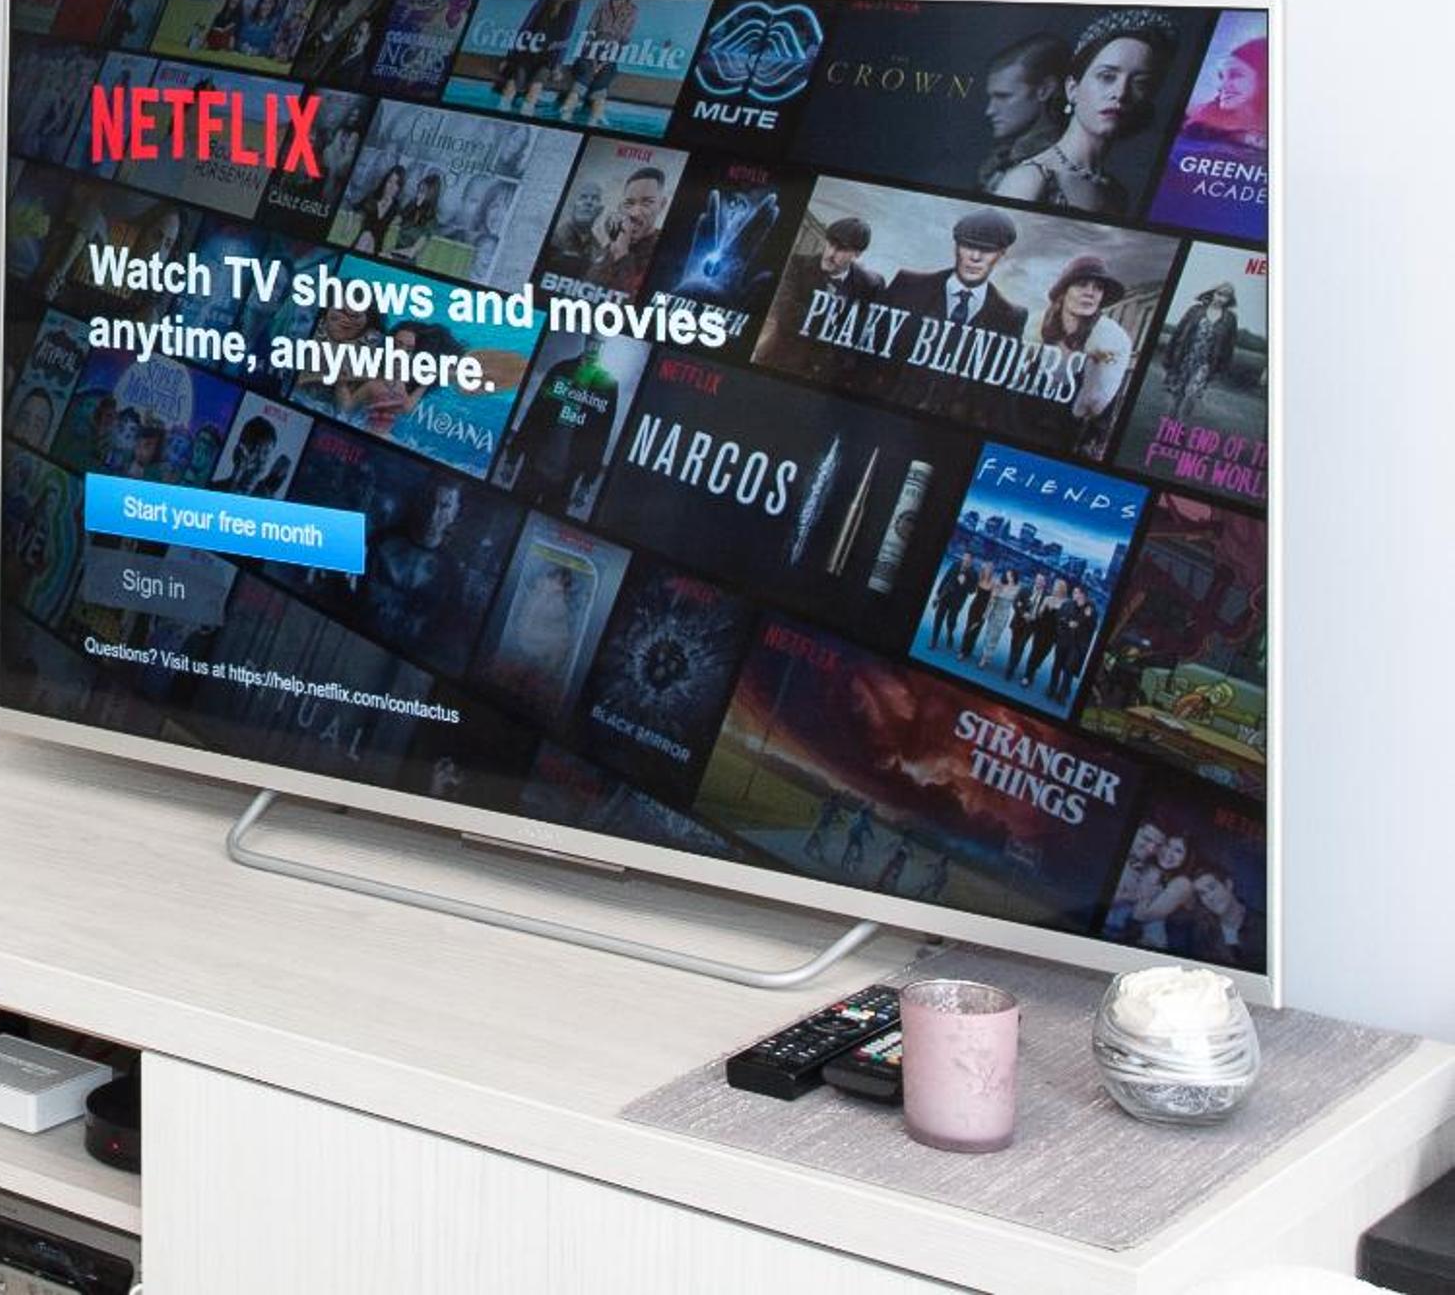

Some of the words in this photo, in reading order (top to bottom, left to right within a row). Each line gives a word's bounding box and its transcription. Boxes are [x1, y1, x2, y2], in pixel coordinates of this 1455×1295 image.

[470, 20, 546, 54] Grace
[572, 30, 687, 71] Frankie
[826, 60, 975, 99] CROWN
[90, 84, 322, 180] NETFLIX
[693, 100, 780, 130] MUTE
[89, 244, 210, 296] Watch
[224, 256, 282, 302] TV
[292, 264, 434, 317] shows
[448, 283, 533, 328] and
[550, 293, 727, 348] movies
[540, 271, 631, 306] BRIGHT
[88, 314, 257, 372] anytime,
[270, 336, 496, 393] anywhere.
[798, 288, 911, 359] PEAKY
[906, 316, 1088, 404] BLINDERS
[552, 380, 608, 414] Breaking
[658, 358, 725, 397] NETFLIX
[559, 404, 588, 427] Bad
[1155, 414, 1185, 444] THE
[1187, 426, 1221, 456] END
[1222, 433, 1248, 463] OF
[627, 412, 798, 517] NARCOS
[976, 457, 1138, 520] FRIENDS
[122, 494, 168, 523] Start
[171, 507, 214, 530] your
[219, 510, 257, 537] free
[260, 520, 323, 548] month
[122, 568, 164, 599] Sign
[168, 575, 186, 600] in
[83, 636, 158, 665] Questions?
[160, 650, 190, 672] Visit
[192, 660, 210, 676] us
[211, 661, 226, 679] at
[227, 664, 461, 725] https://help.netflix.com/contactus
[953, 709, 1122, 806] STRANGER
[968, 746, 1088, 826] THINGS
